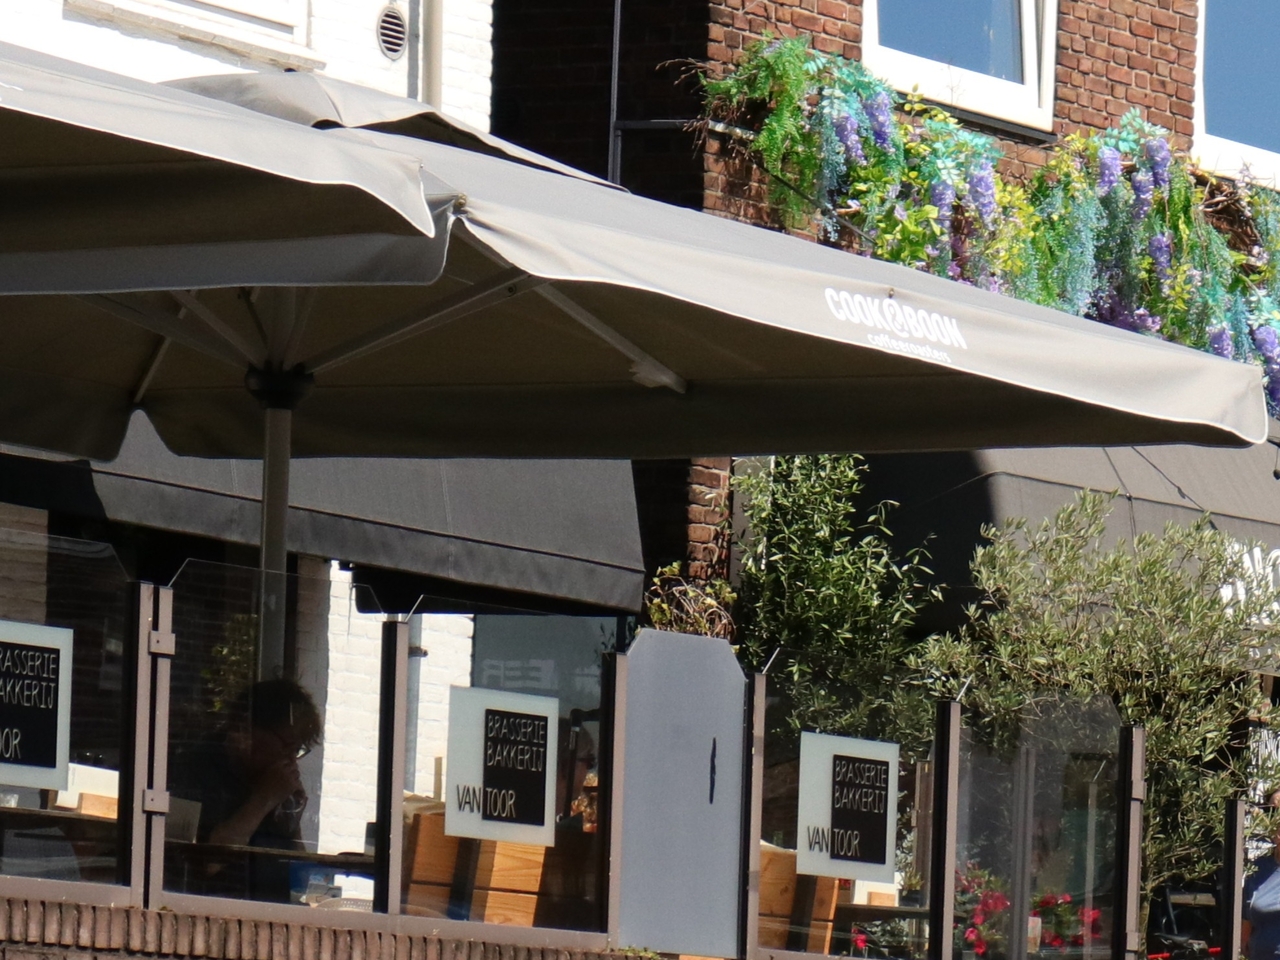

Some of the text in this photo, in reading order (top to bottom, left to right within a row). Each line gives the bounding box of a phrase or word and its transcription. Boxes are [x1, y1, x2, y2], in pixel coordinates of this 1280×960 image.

[867, 333, 952, 363] coffeeroasters
[487, 715, 546, 744] BRASSERIE
[486, 742, 545, 772] BAKKERIJ
[835, 760, 888, 787] BRASSERIE
[457, 783, 517, 819] VAN TOOR
[834, 785, 887, 814] BAKKERIJ
[807, 825, 860, 858] VAN TOOR
